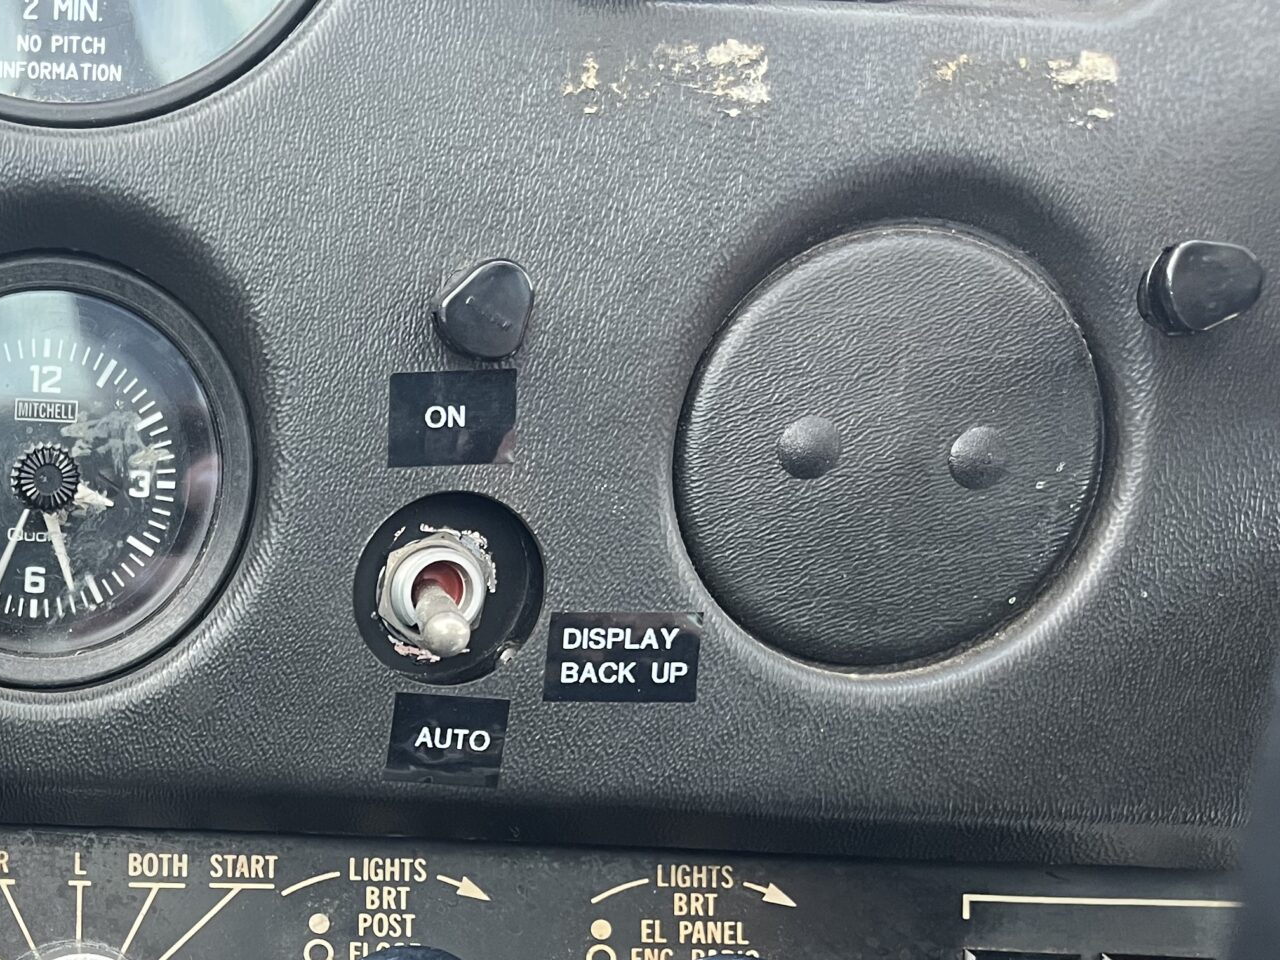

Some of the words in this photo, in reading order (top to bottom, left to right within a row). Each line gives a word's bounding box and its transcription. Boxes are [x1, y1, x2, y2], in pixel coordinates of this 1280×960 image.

[23, 0, 39, 20] 2
[54, 0, 102, 22] MIN.
[16, 34, 42, 52] NO
[51, 35, 106, 54] PITCH
[30, 365, 62, 393] 12
[19, 402, 74, 419] MITCHELL
[424, 405, 466, 429] ON
[128, 470, 150, 498] 3
[24, 566, 46, 593] 6
[562, 628, 680, 650] DISPLAY
[560, 661, 637, 684] BACK
[651, 662, 688, 684] UP
[415, 727, 491, 752] AUTO
[74, 852, 87, 875] L
[128, 853, 188, 877] BOTH
[209, 854, 278, 879] START
[349, 857, 427, 882] LIGHTS
[657, 864, 734, 889] LIGHTS
[365, 886, 411, 910] BRT
[673, 893, 718, 916] BRT
[358, 912, 416, 938] POST
[640, 919, 668, 943] EL
[679, 921, 750, 945] PANEL
